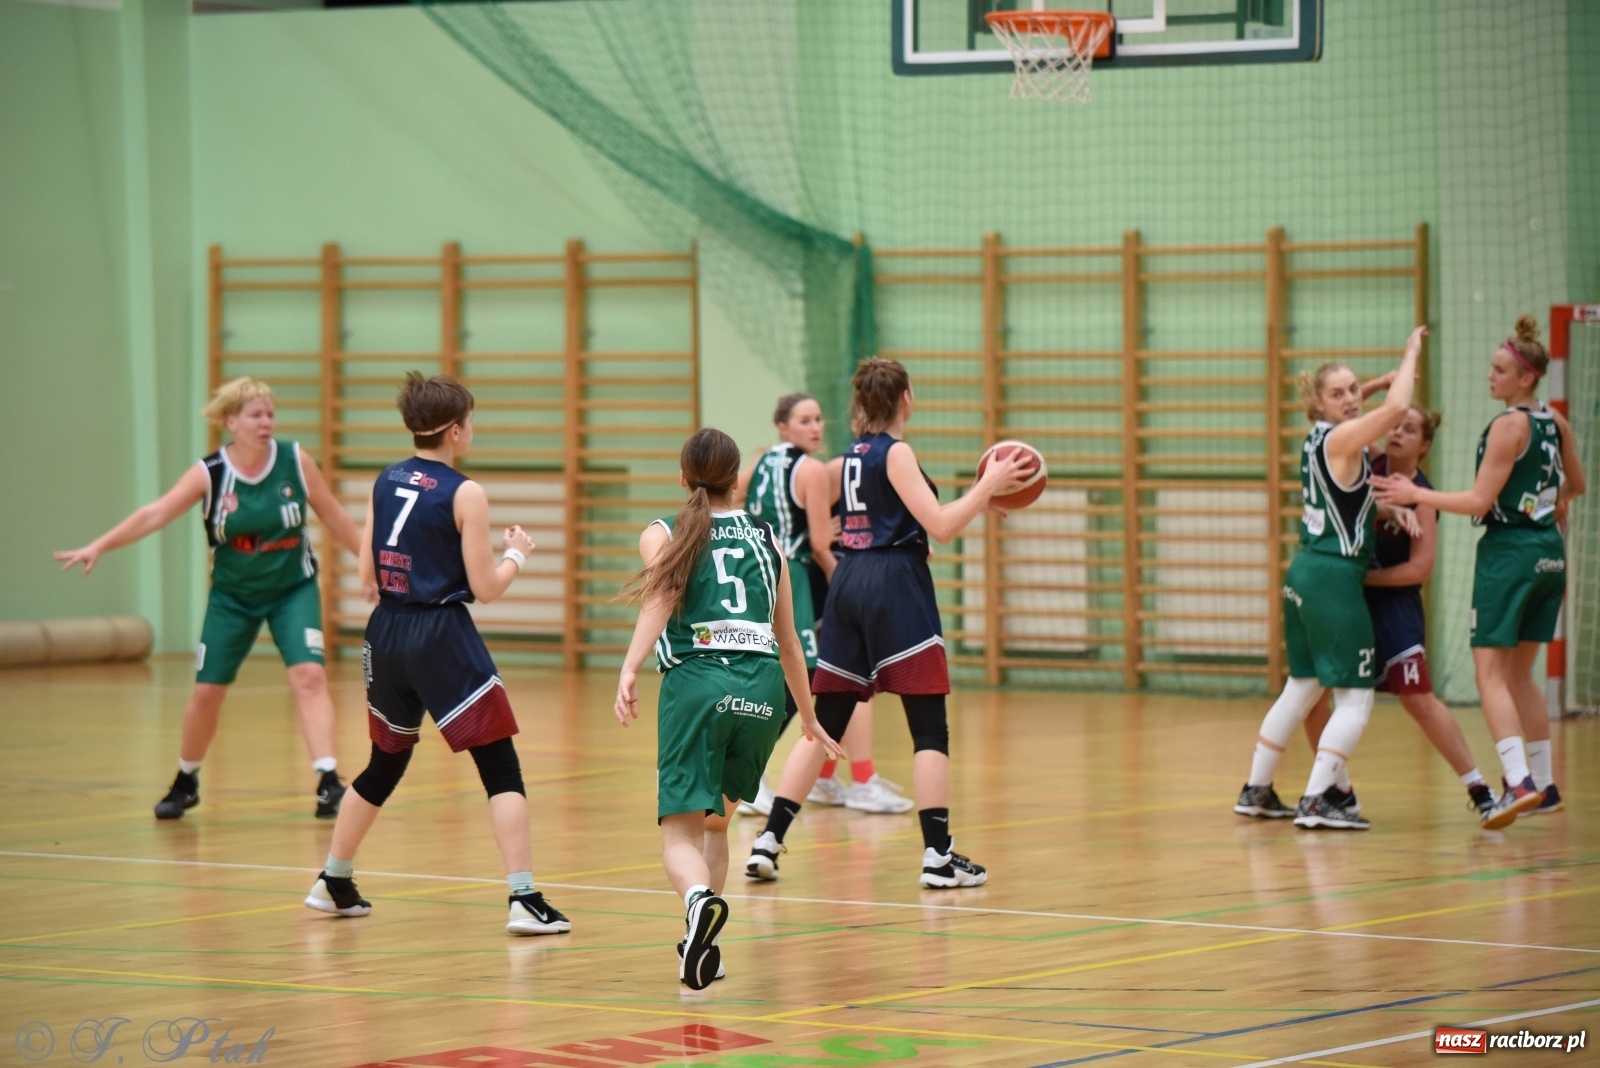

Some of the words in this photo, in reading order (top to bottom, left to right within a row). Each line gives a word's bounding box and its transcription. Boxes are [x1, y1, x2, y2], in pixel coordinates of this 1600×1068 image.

[844, 457, 867, 511] 12
[281, 501, 301, 529] 10
[386, 487, 419, 547] 7
[710, 522, 767, 542] RACIBÓRZ
[712, 547, 747, 613] 5
[713, 633, 774, 647] WAGTECH
[1402, 662, 1420, 685] 14
[731, 698, 774, 717] Clavis
